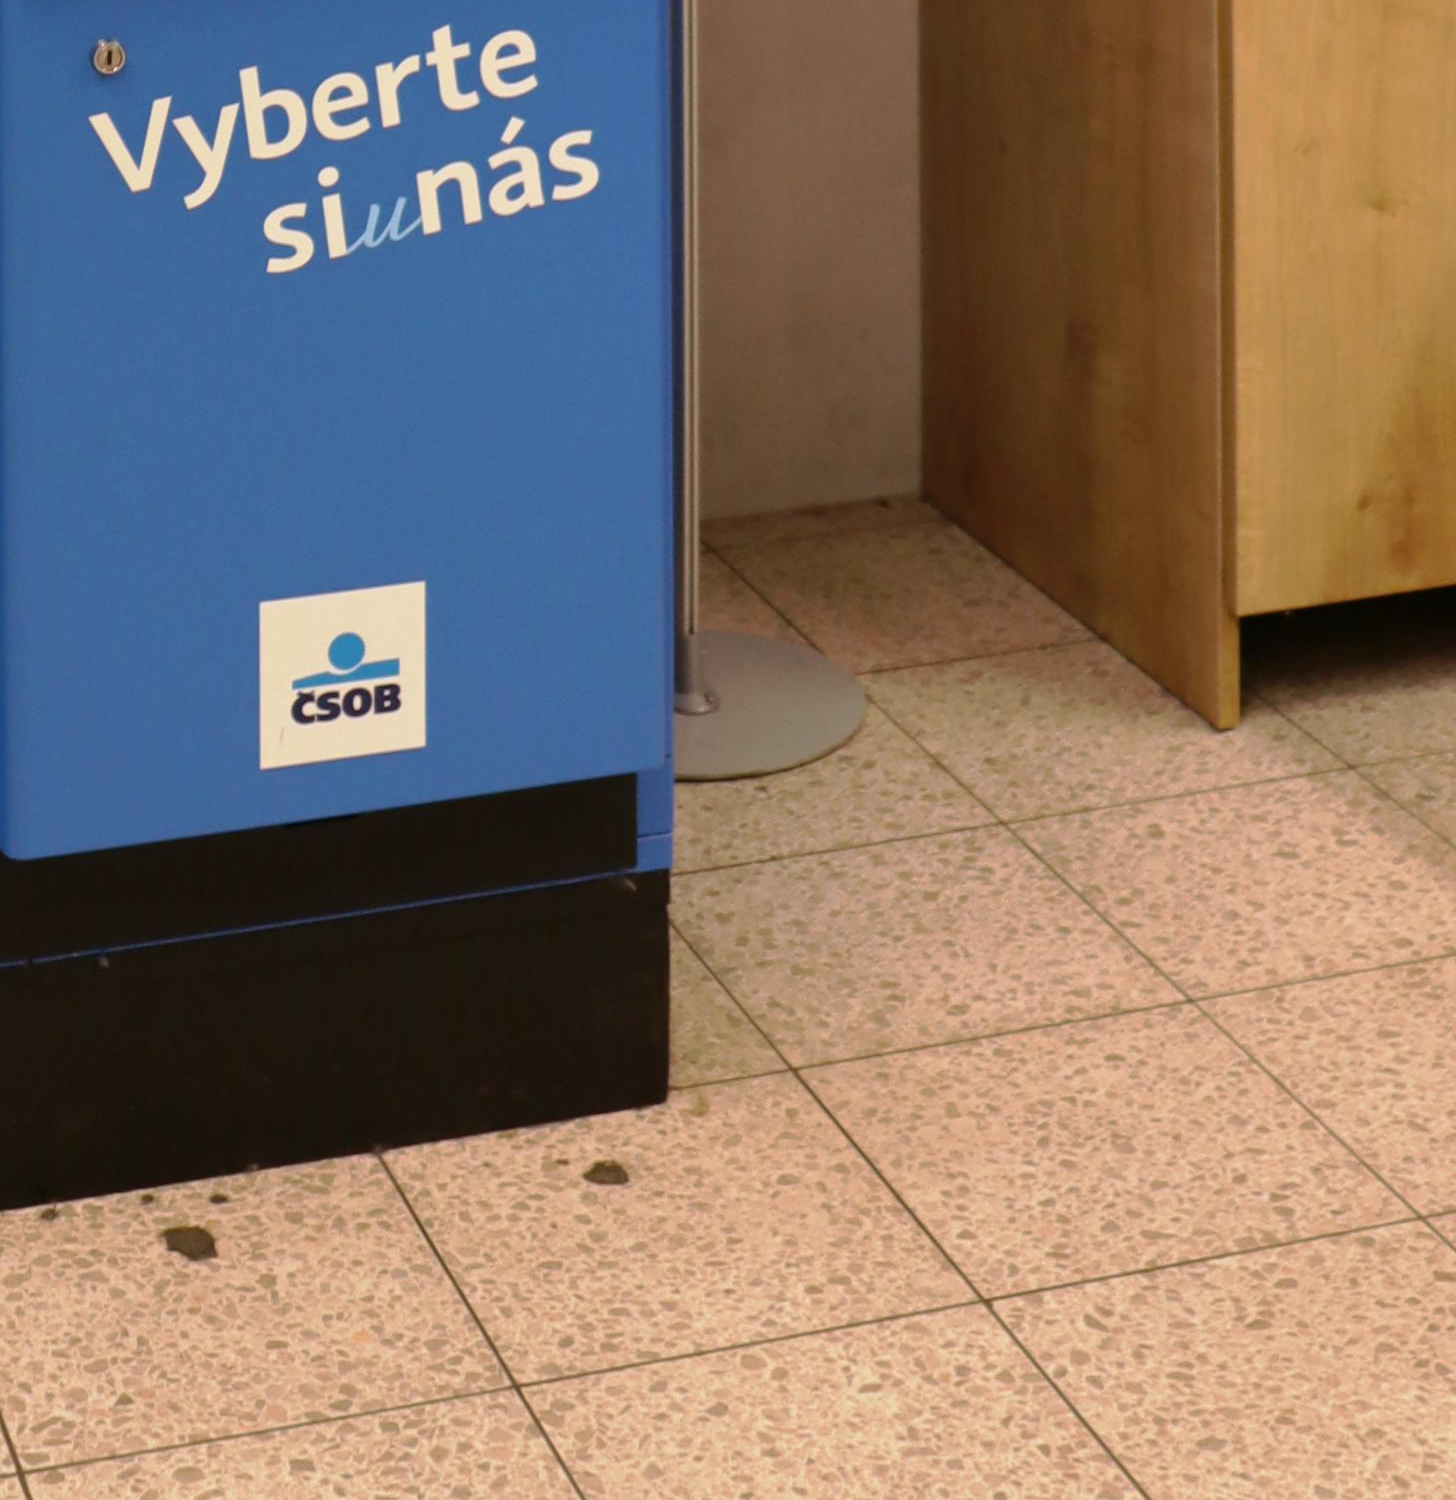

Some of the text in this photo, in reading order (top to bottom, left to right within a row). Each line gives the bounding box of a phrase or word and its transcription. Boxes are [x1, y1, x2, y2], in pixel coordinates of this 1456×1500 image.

[89, 24, 539, 211] Vyberte
[263, 166, 348, 274] si
[416, 116, 600, 236] nás
[291, 683, 402, 725] ČSOB
